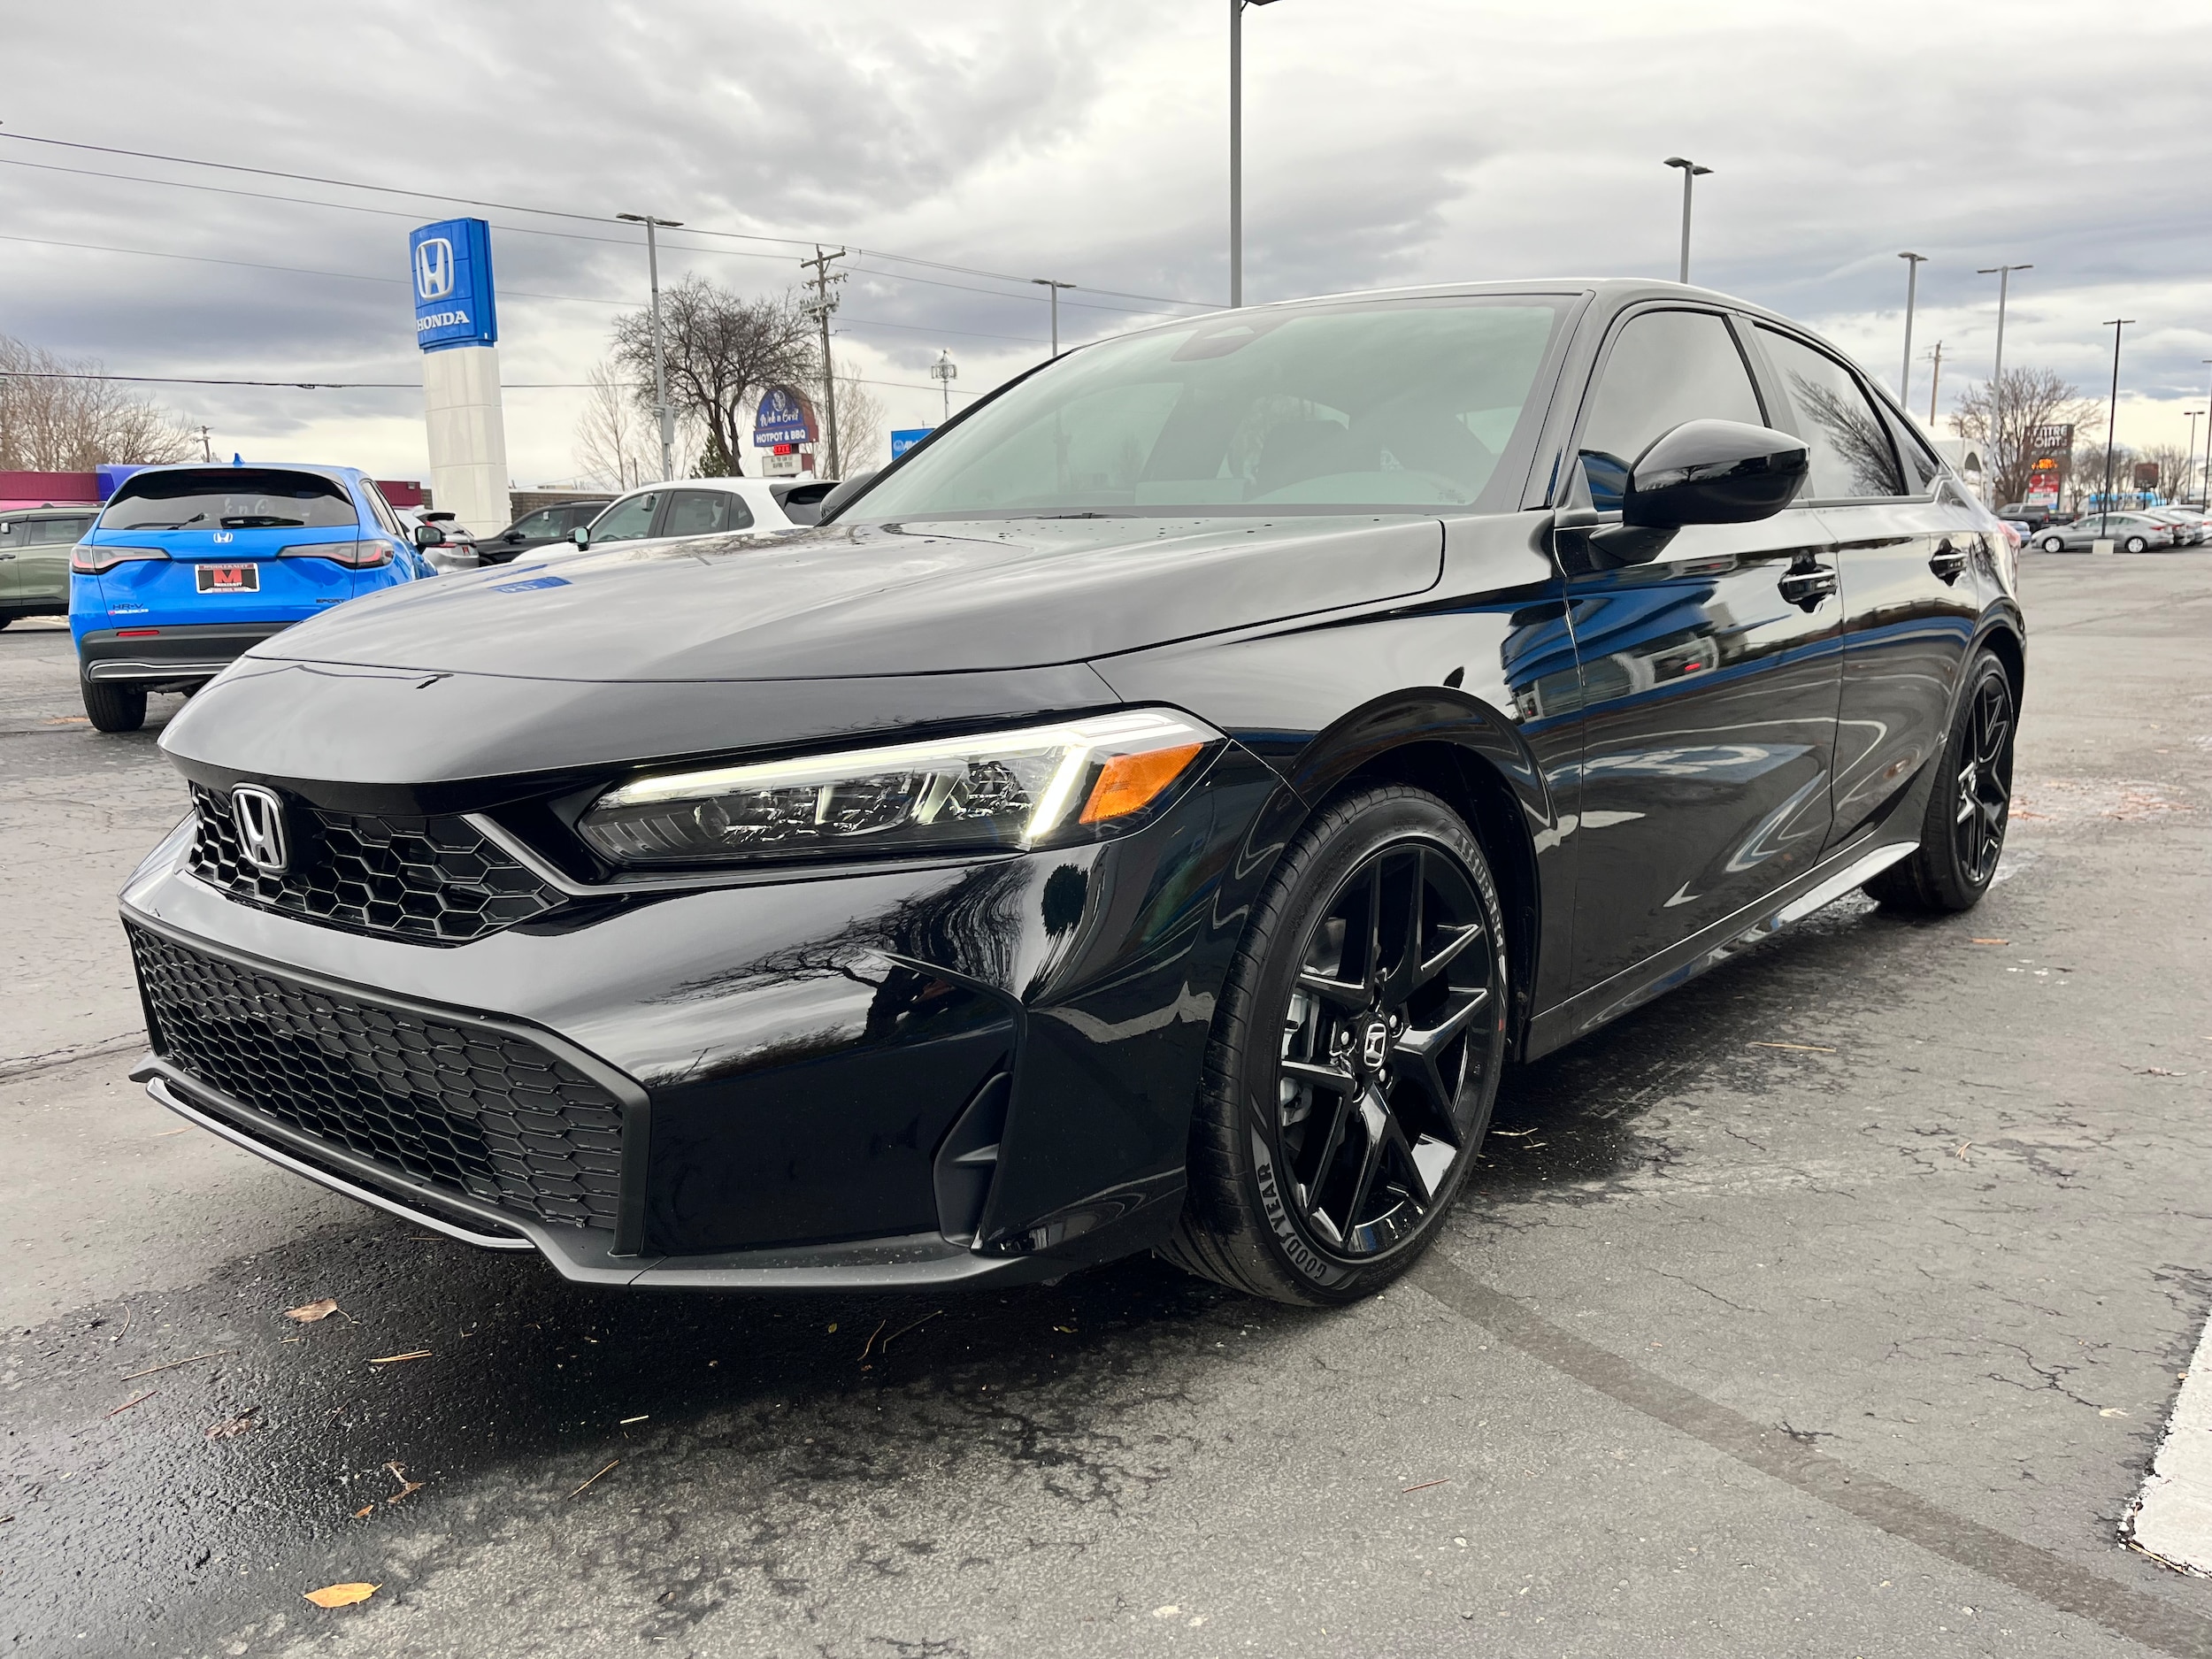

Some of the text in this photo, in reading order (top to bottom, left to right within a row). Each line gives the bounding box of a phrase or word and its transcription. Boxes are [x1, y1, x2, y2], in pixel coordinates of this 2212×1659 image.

[417, 311, 470, 332] HONDA
[756, 428, 806, 443] HOTPOT & BBQ
[213, 569, 243, 584] M
[1256, 1162, 1328, 1279] GOODYEAR
